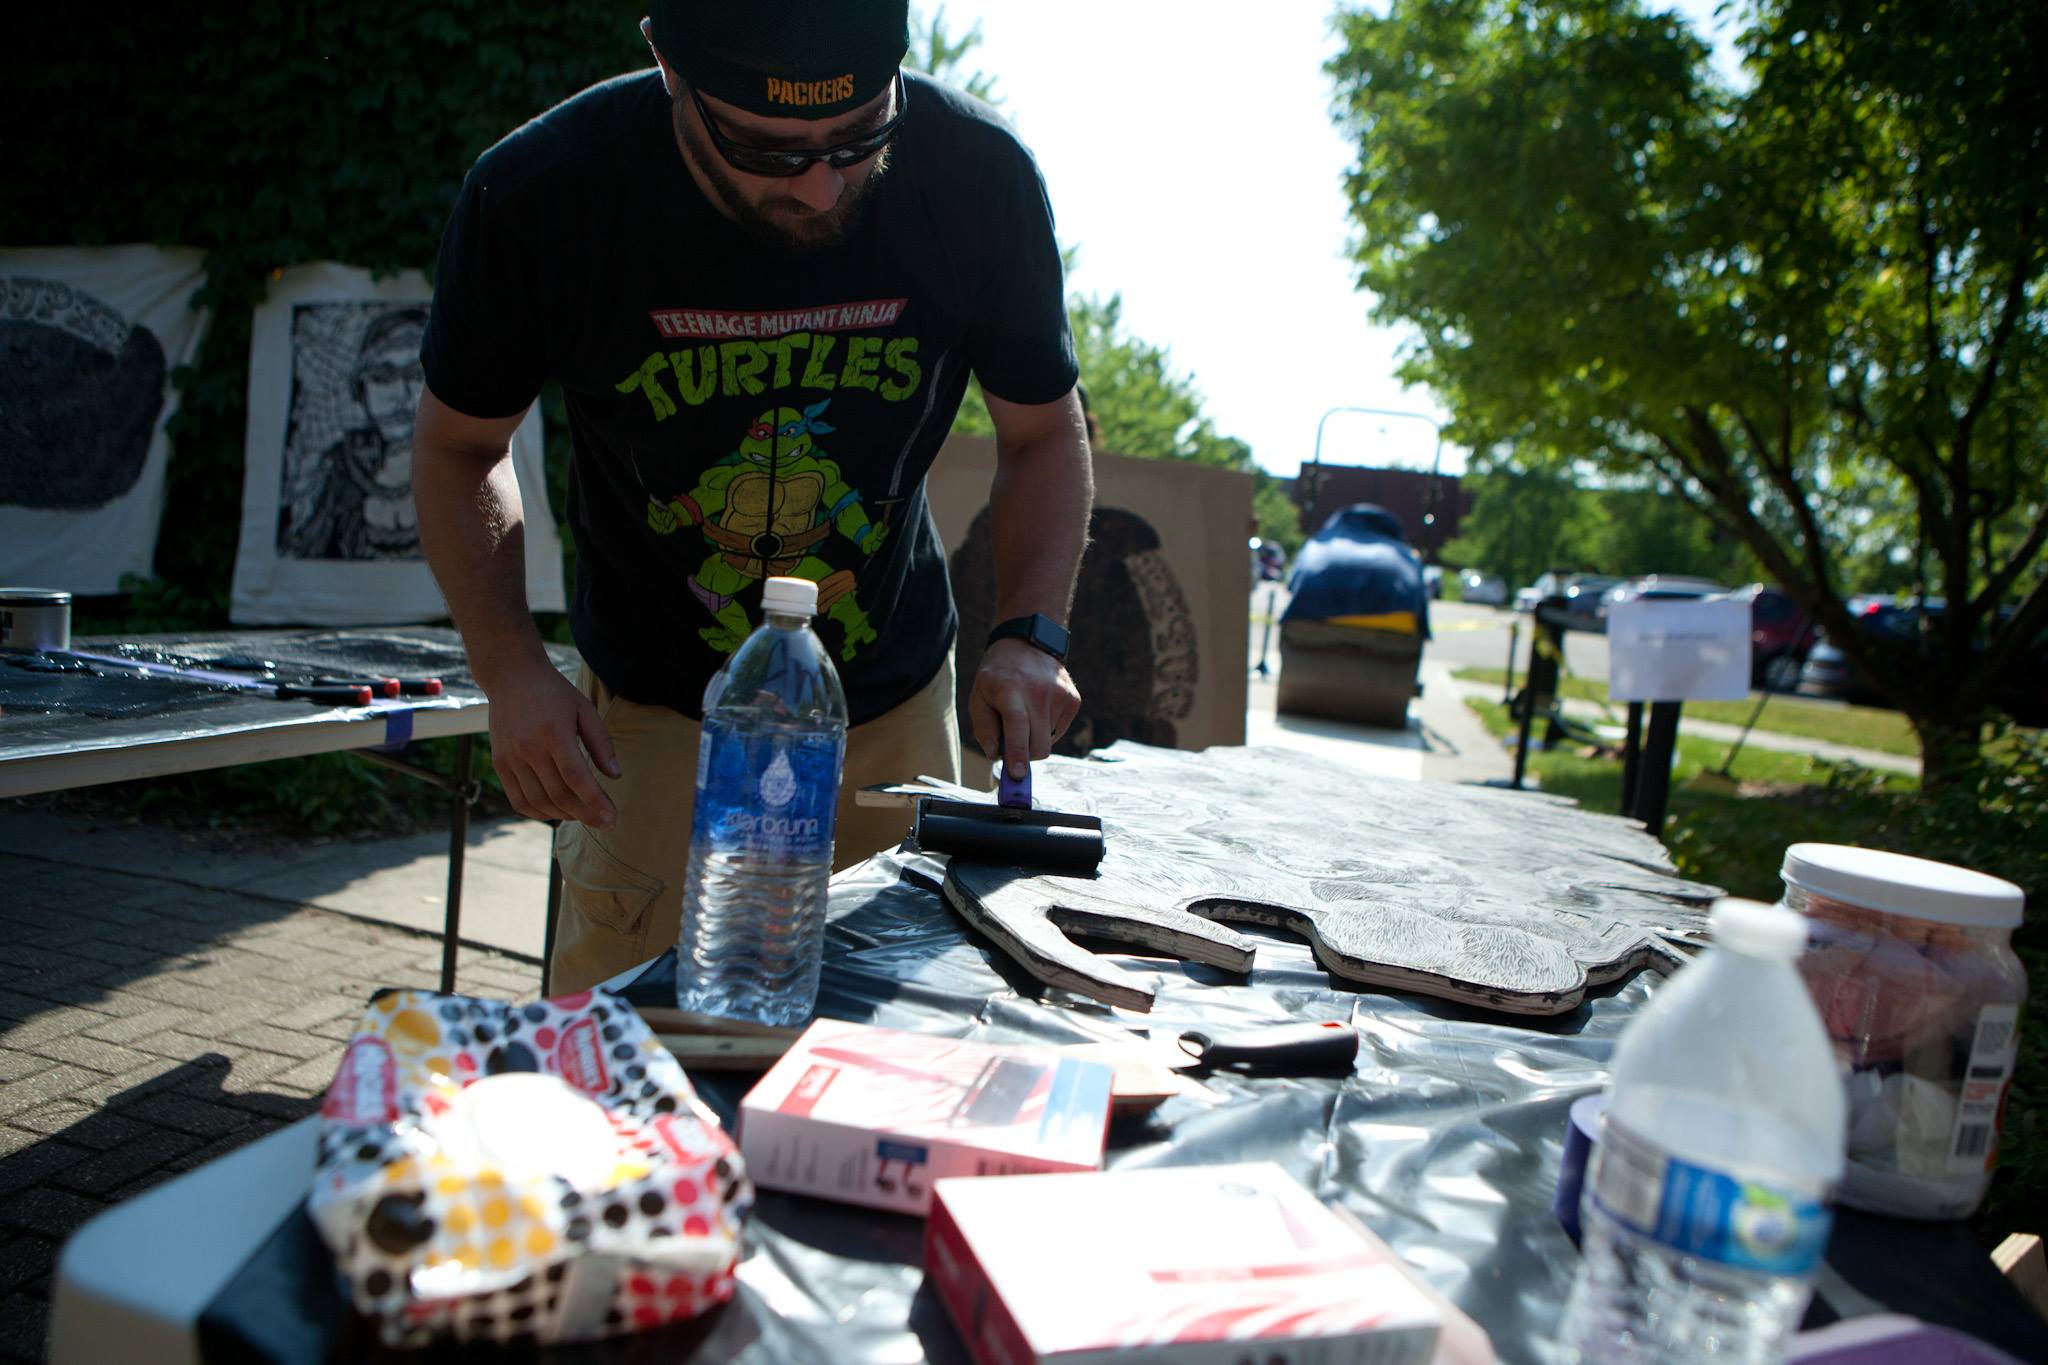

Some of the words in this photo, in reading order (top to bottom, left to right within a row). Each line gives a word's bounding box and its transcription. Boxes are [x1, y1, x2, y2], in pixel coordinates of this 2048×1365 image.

[767, 73, 854, 106] PACKERS
[653, 312, 757, 337] TEENAGE
[760, 308, 838, 336] MUTANT
[838, 301, 900, 328] NINJA
[615, 332, 922, 422] TURTLES
